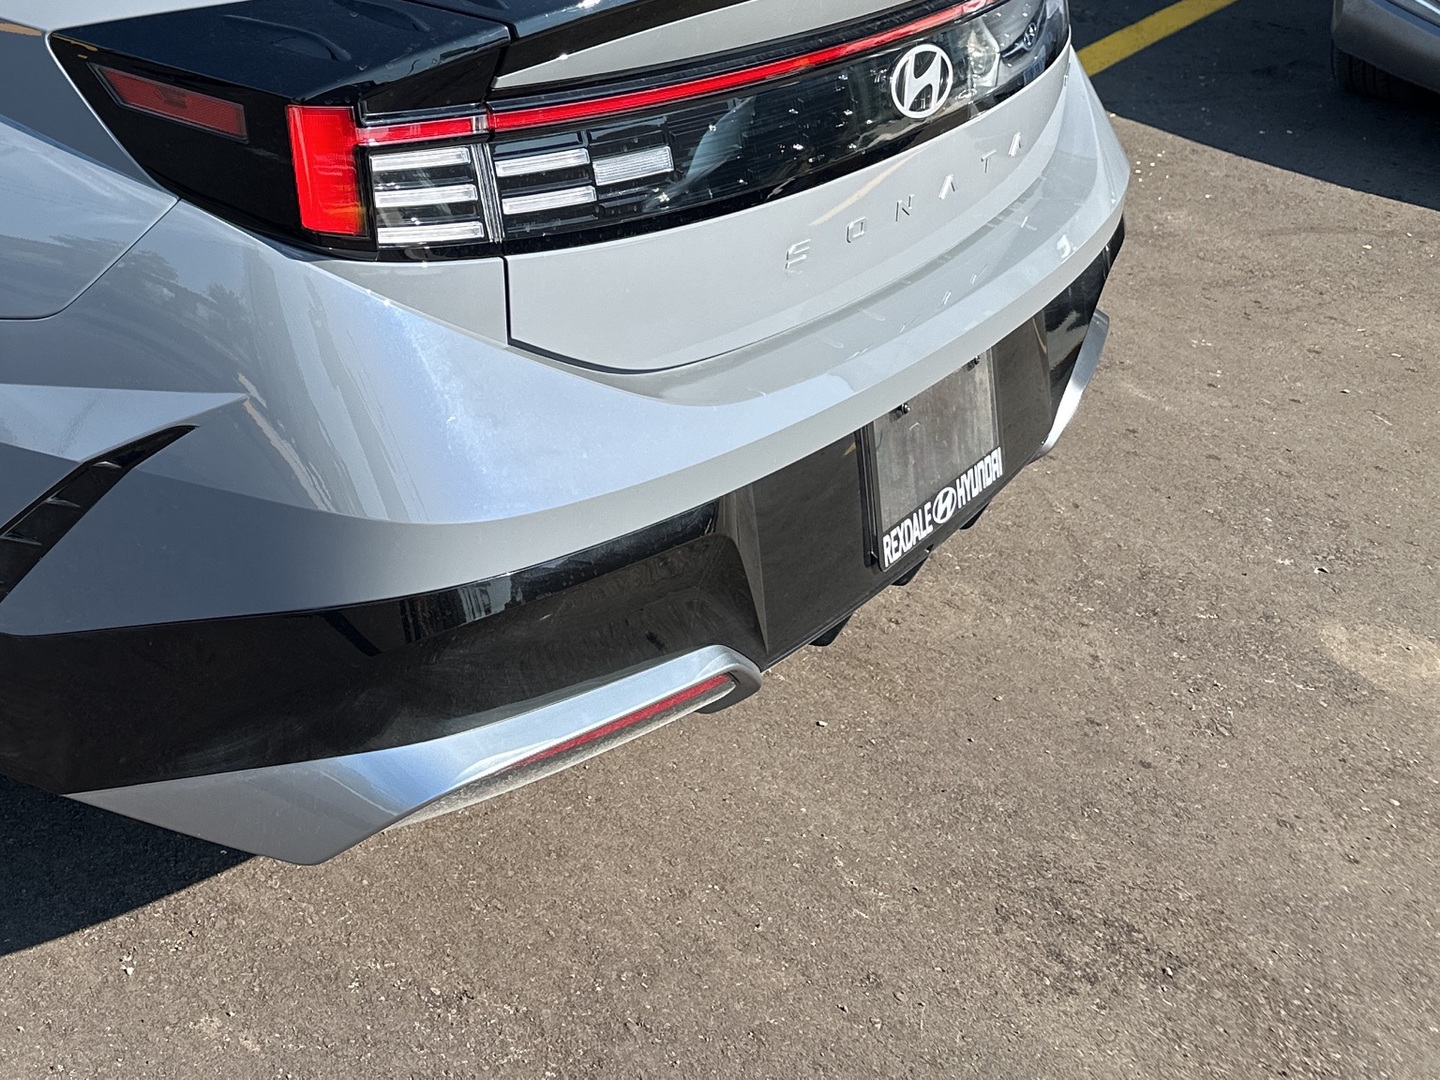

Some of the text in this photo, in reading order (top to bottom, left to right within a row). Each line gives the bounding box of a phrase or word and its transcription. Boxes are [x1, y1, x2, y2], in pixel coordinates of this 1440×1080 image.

[784, 131, 1023, 270] SONATA
[882, 446, 1004, 568] REXDALE HYUNDAI
